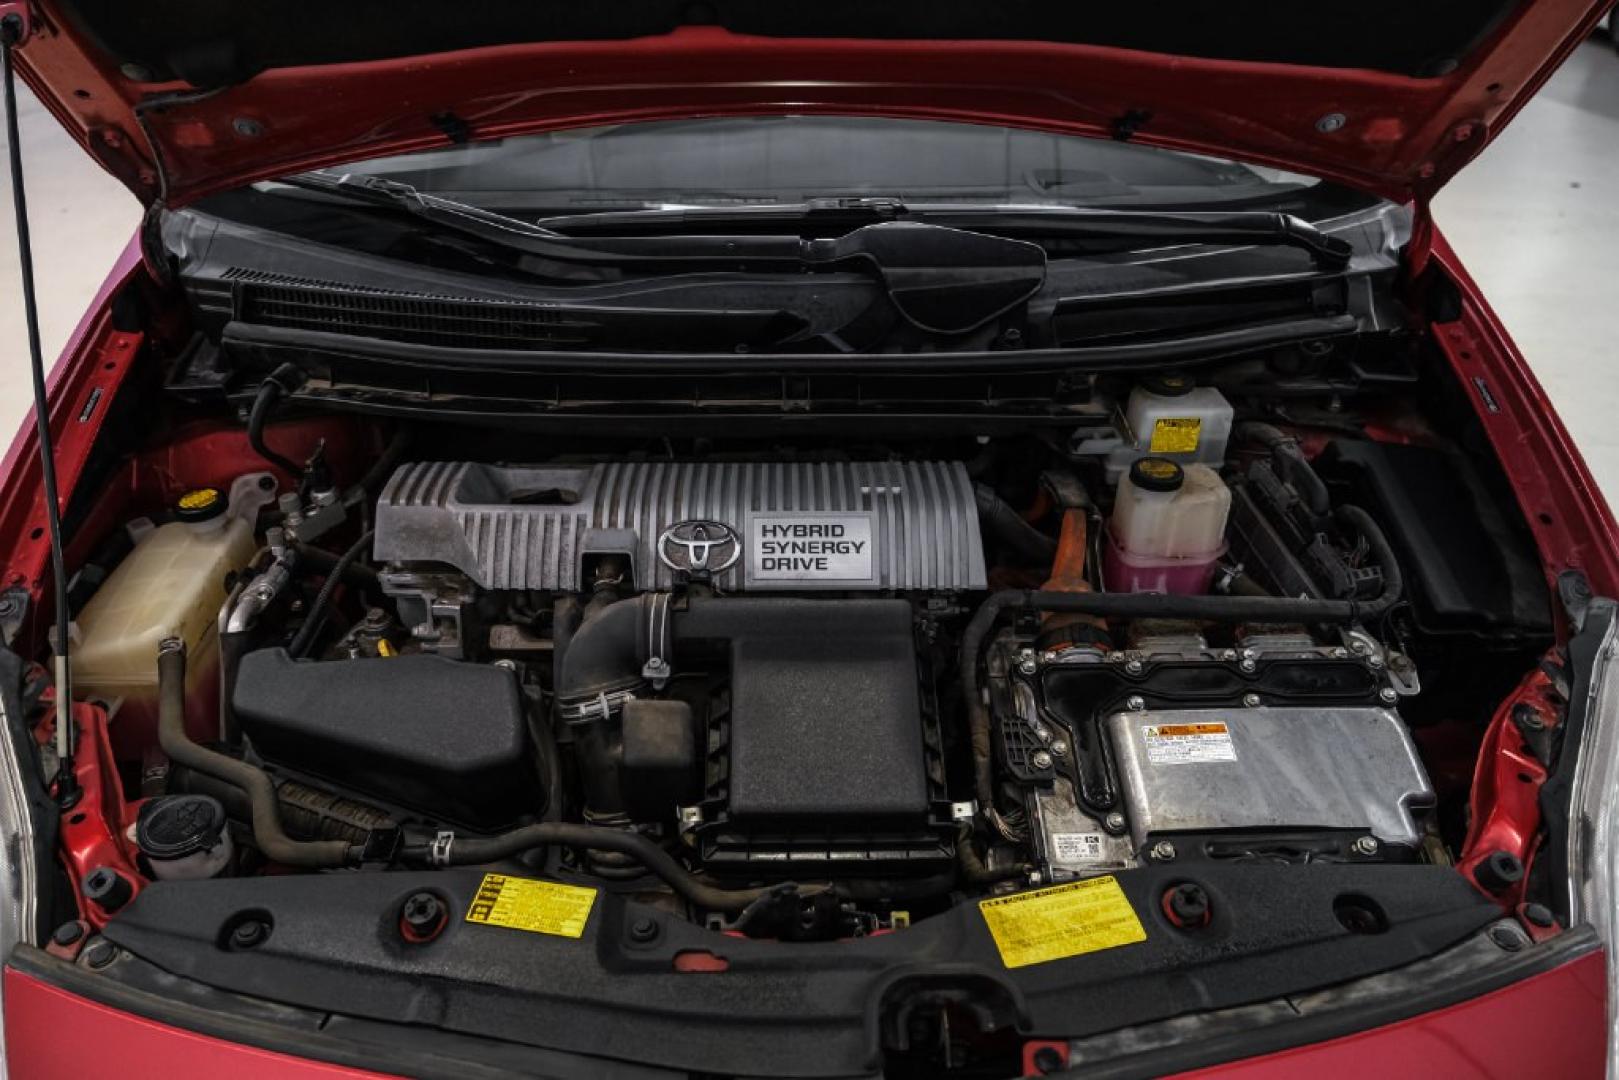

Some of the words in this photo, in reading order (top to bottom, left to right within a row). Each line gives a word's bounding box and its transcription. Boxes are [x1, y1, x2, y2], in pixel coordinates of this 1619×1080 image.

[762, 525, 844, 537] HYBRID
[762, 541, 865, 554] SYNERGY
[762, 558, 828, 570] DRIVE
